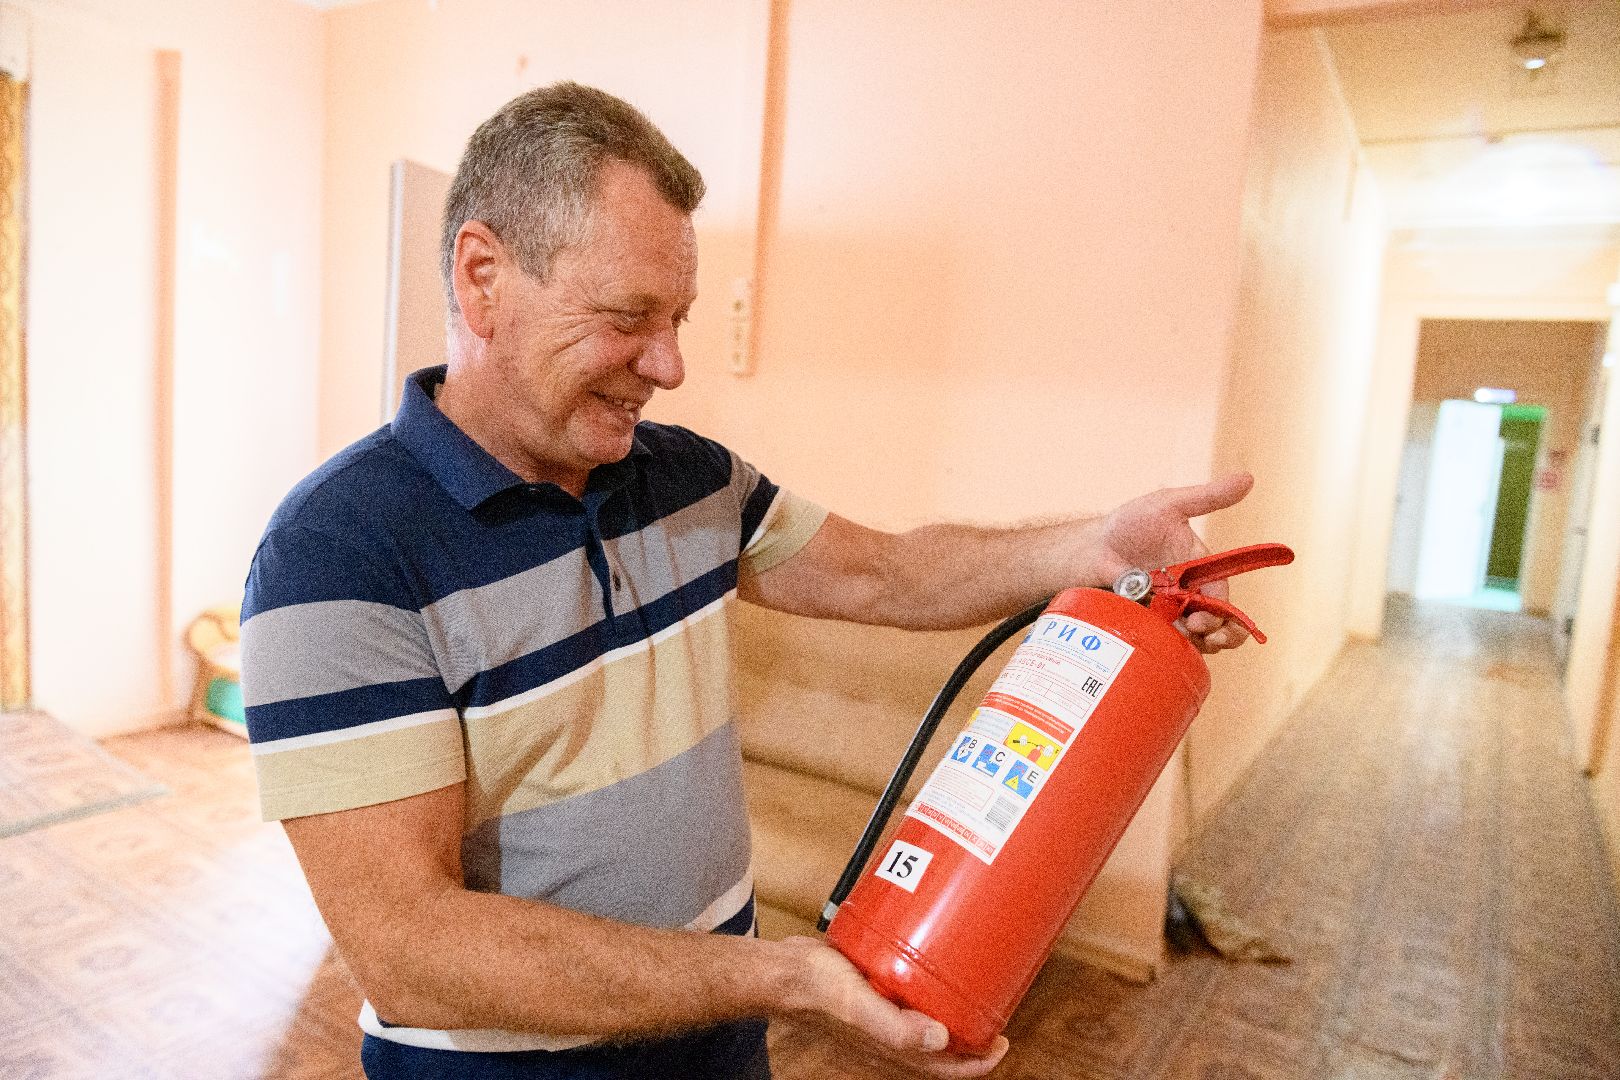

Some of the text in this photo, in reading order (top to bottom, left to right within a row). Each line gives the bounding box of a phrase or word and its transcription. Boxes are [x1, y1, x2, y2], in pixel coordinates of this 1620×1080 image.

[1043, 620, 1101, 650] РИФ
[968, 739, 1039, 784] B C E
[886, 850, 919, 879] 15
